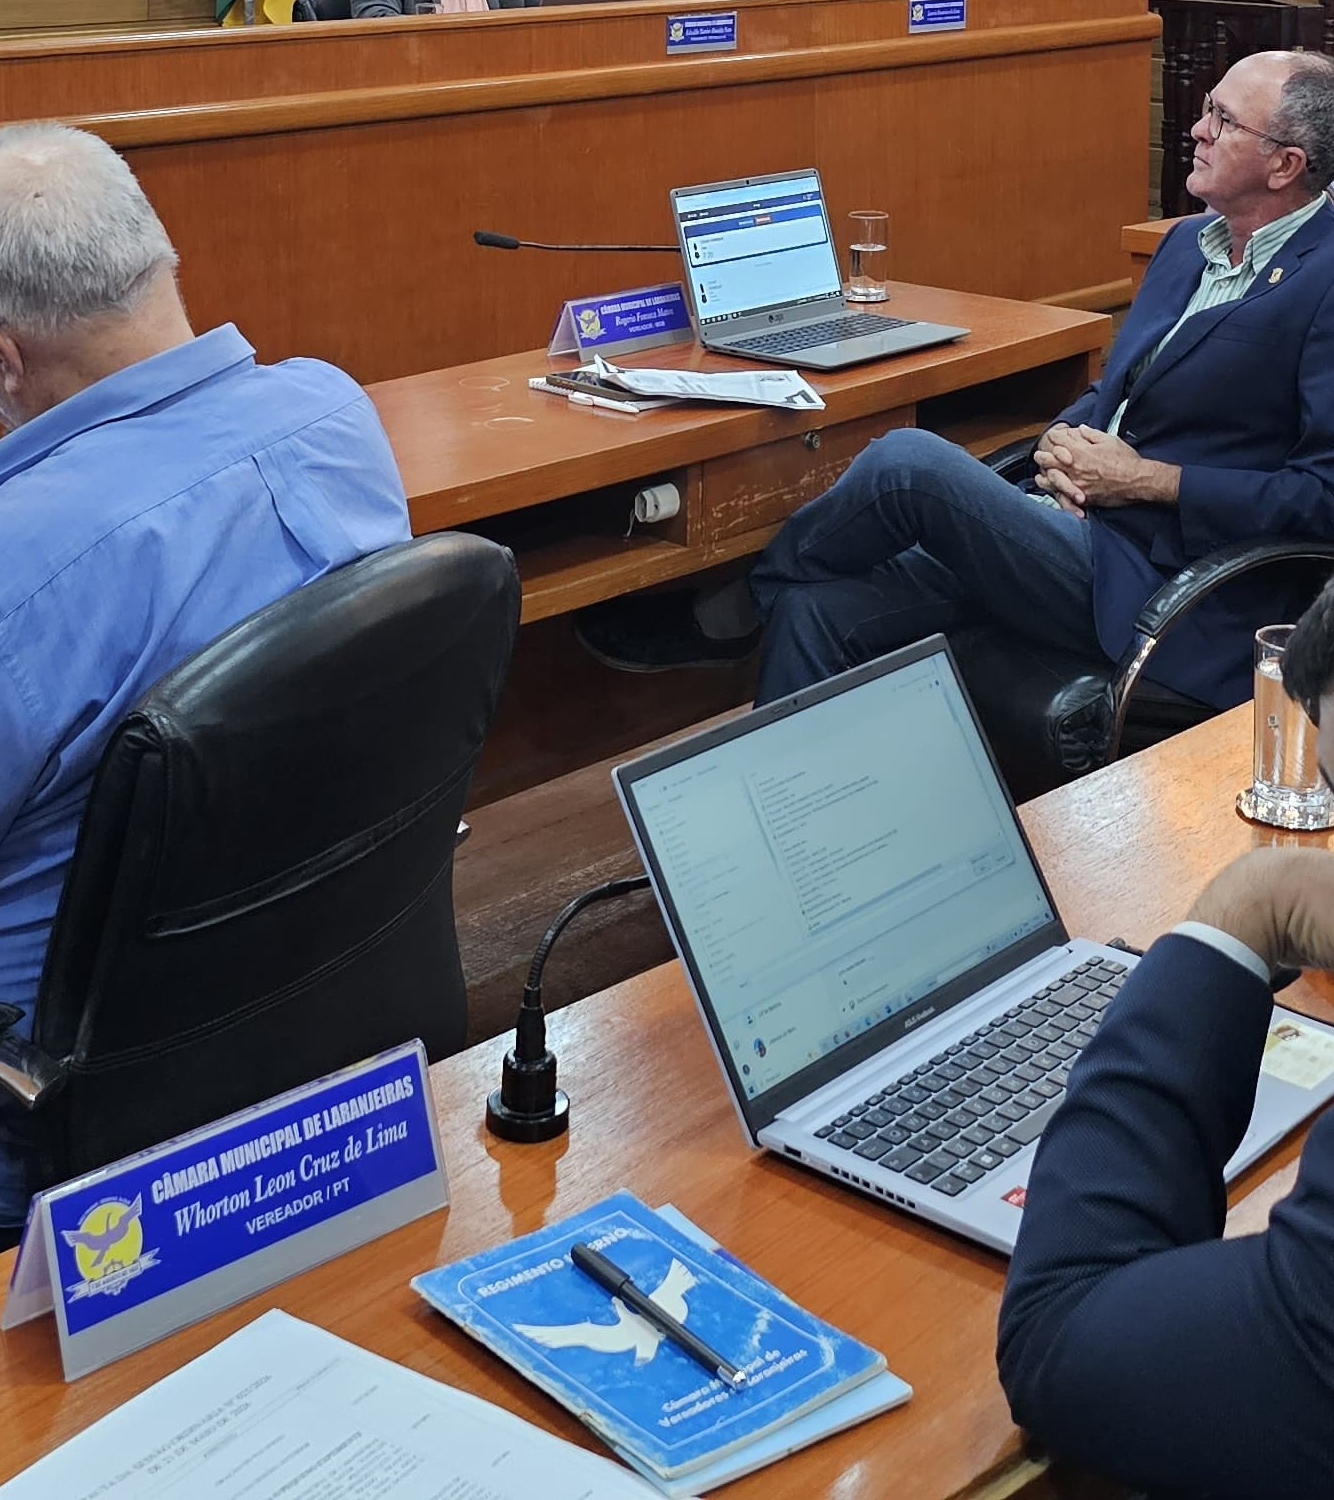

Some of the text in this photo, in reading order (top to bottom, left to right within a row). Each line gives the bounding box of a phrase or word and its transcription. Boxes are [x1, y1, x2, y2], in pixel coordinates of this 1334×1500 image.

[151, 1074, 414, 1205] CÂMARA MUNICIPAL DE LARANJEIRAS
[173, 1119, 408, 1237] Whorton Leon Cruz de Lima
[245, 1188, 324, 1236] VEREADOR
[333, 1177, 351, 1201] PT
[477, 1258, 565, 1297] REGIMENTO
